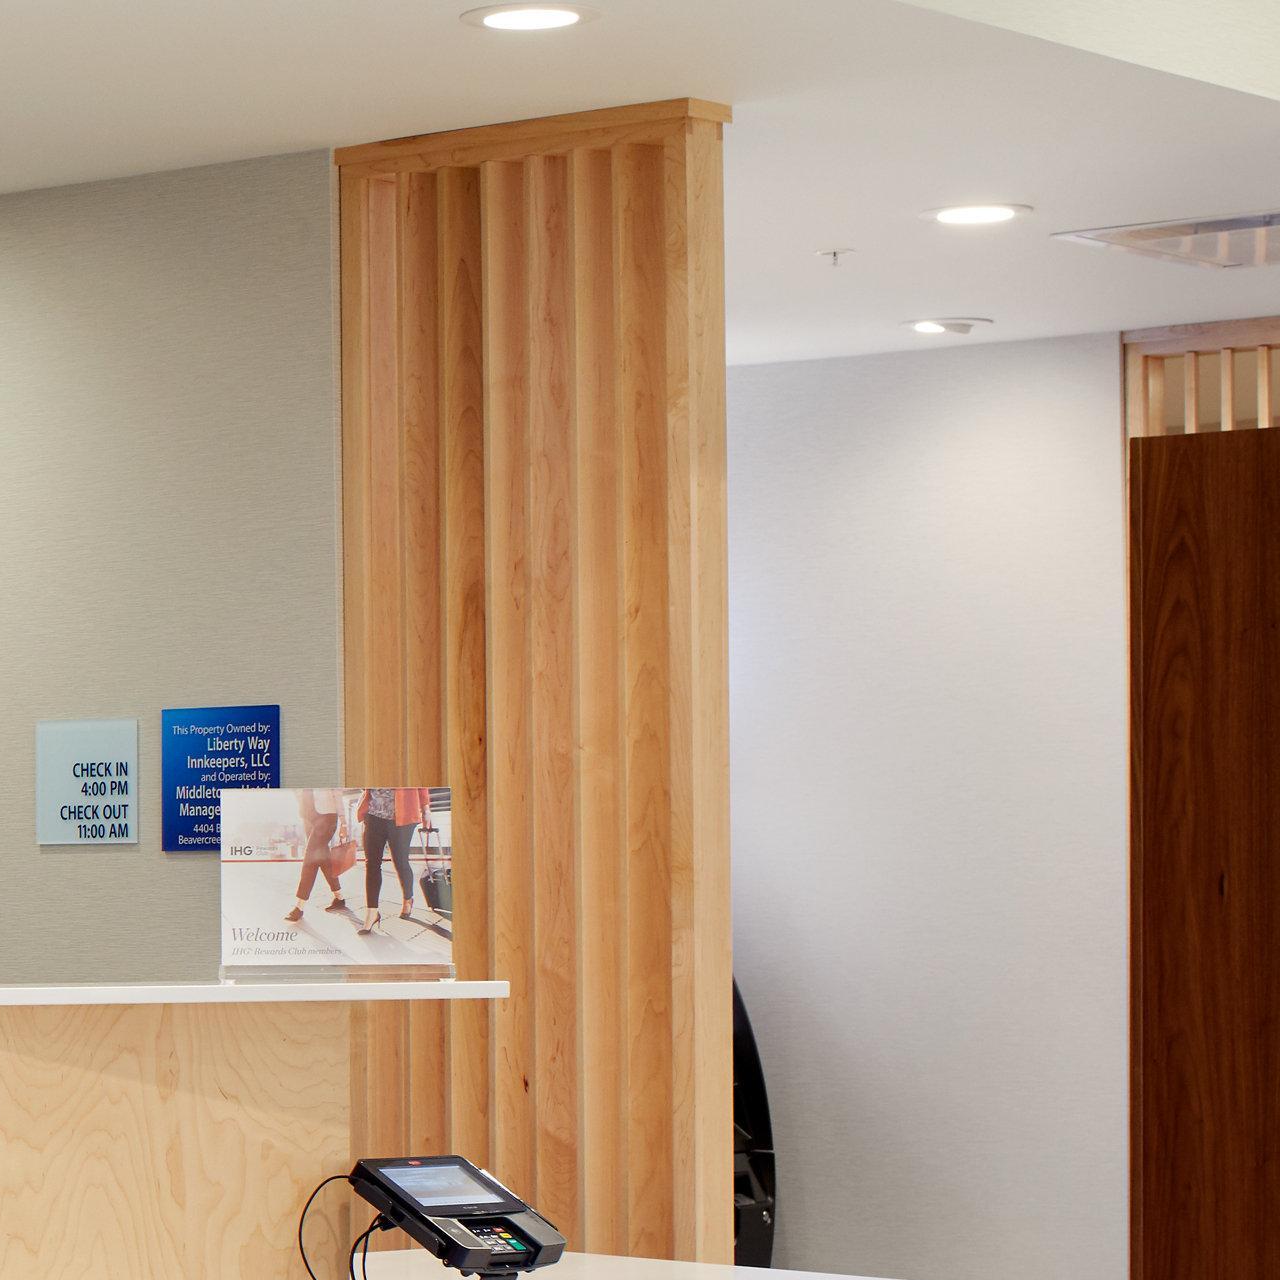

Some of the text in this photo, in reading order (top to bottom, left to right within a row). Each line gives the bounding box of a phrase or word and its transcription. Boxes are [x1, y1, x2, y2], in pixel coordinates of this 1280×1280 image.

[172, 722, 271, 736] This Property Owned by:
[207, 735, 271, 754] Liberty Way
[72, 761, 129, 778] CHECK IN
[187, 752, 271, 771] Innkeepers, LLC
[200, 770, 271, 784] and Operated by:
[81, 780, 129, 796] 4:00 PM
[175, 784, 221, 800] Middleto
[60, 804, 129, 820] CHECK OUT
[179, 802, 221, 820] Manage
[77, 822, 129, 838] 11:00 AM
[193, 823, 214, 834] 4404
[178, 834, 221, 845] Beavercree
[230, 846, 253, 856] IHG
[231, 927, 298, 942] Welcome
[254, 946, 287, 956] Rewards
[288, 946, 307, 956] Club
